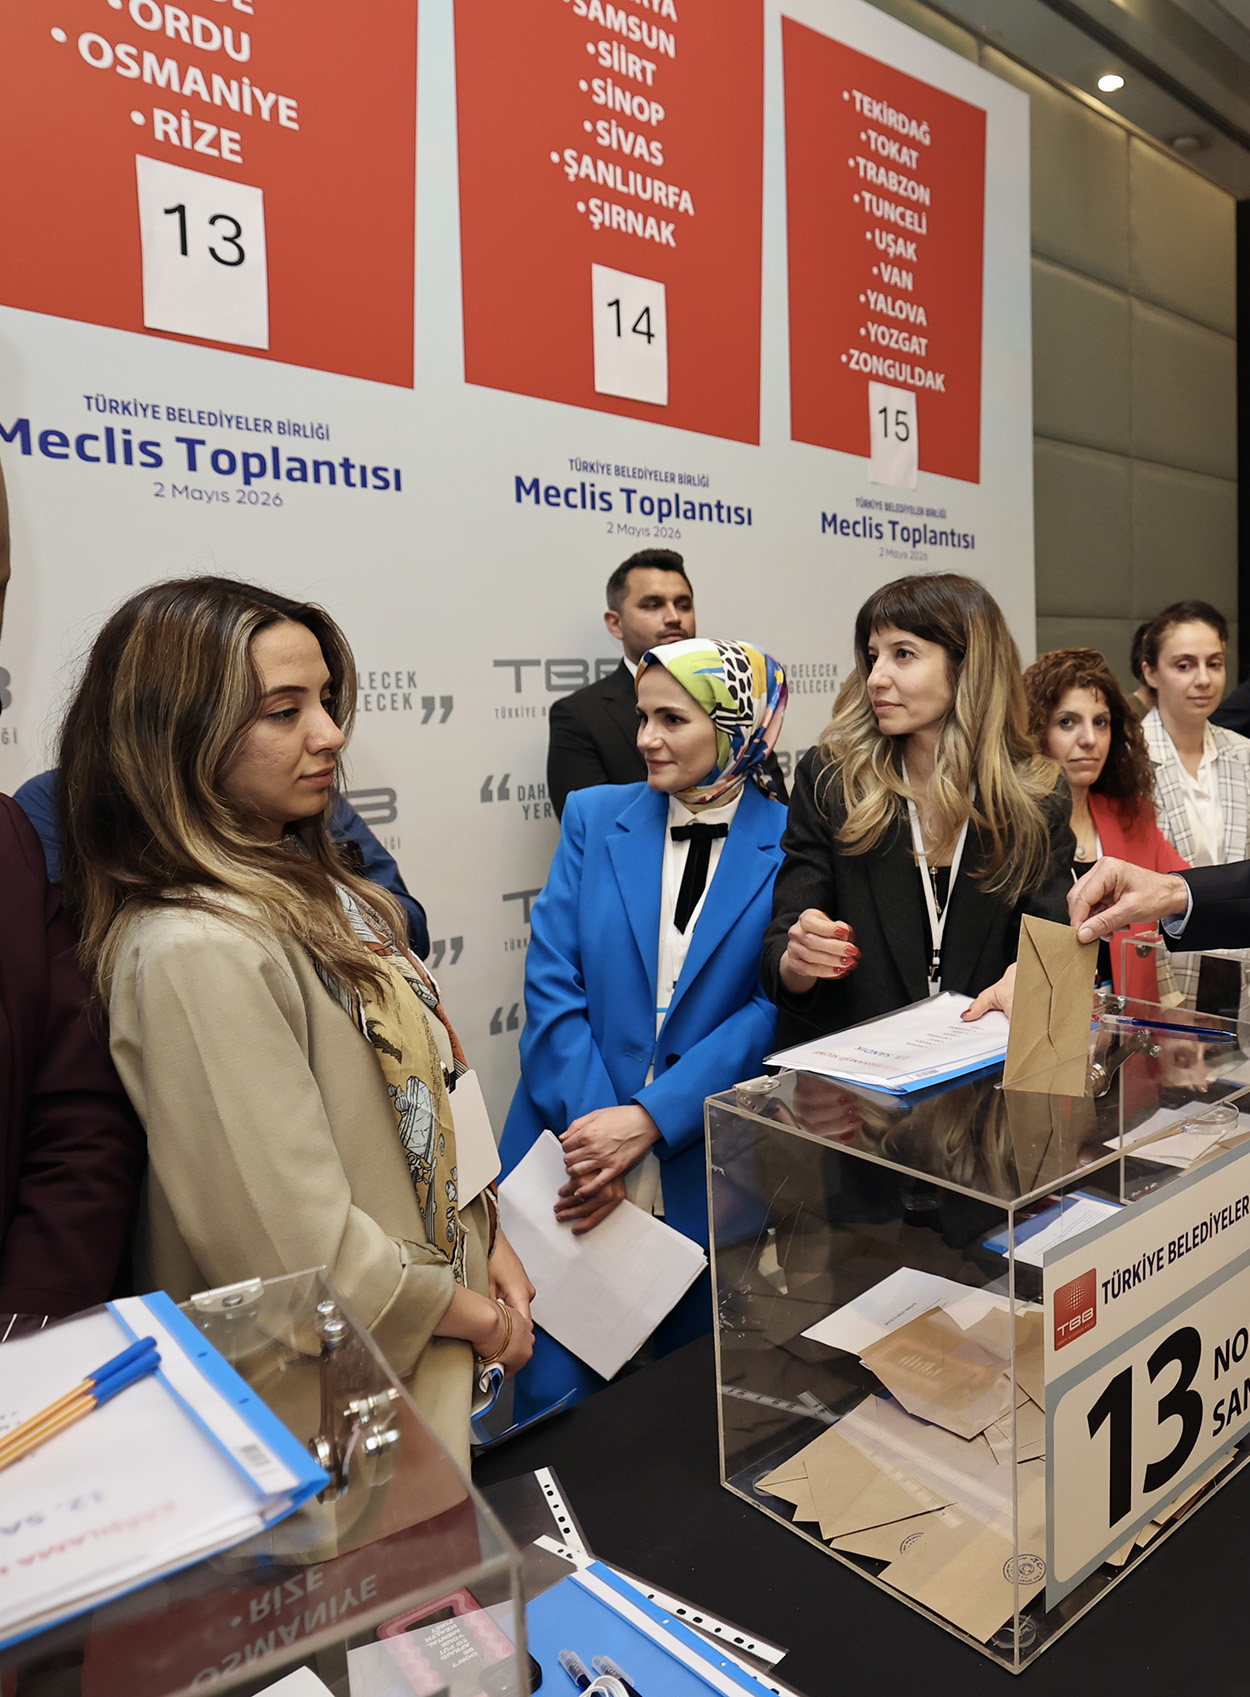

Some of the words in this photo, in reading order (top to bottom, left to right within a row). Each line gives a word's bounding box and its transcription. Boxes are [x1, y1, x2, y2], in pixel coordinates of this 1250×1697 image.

[129, 0, 250, 62] ORDU
[573, 0, 676, 58] SAMSUN
[77, 32, 300, 131] OSMANİYE
[597, 40, 657, 86] SİİRT
[591, 77, 665, 127] SİNOP
[852, 89, 931, 146] TEKİRDAĞ
[153, 107, 243, 164] RİZE
[596, 119, 664, 166] SİVAS
[867, 128, 919, 170] TOKAT
[563, 148, 695, 216] ŞANLIURFA
[856, 155, 931, 207] TRABZON
[588, 197, 677, 248] ŞIRNAK
[861, 190, 927, 236] TUNCELİ
[163, 204, 245, 266] 13
[874, 228, 918, 262] UŞAK
[880, 261, 913, 291] VAN
[607, 298, 655, 344] 14
[866, 288, 927, 327] YALOVA
[867, 321, 928, 357] YOZGAT
[849, 348, 946, 392] ZONGULDAK
[83, 394, 161, 421] TÜRKİYE
[165, 406, 273, 434] BELEDİYELER
[277, 418, 330, 441] BİRLİĞİ
[878, 406, 909, 441] 15
[0, 417, 163, 469] Meclis
[175, 436, 402, 492] Toplantısı
[568, 457, 611, 476] TÜRKİYE
[614, 465, 676, 484] BELEDİYELER
[678, 471, 710, 488] BİRLİĞİ
[153, 481, 166, 498] 2
[172, 483, 229, 505] Mayıs
[236, 489, 283, 508] 2026
[514, 475, 613, 512] Meclis
[620, 488, 753, 526] Toplantısı
[606, 521, 614, 534] 2
[617, 523, 650, 537] Mayıs
[653, 526, 681, 539] 2026
[821, 511, 884, 540] Meclis
[888, 520, 975, 549] Toplantısı
[358, 671, 417, 690] LECEK
[363, 692, 413, 712] ECEK
[495, 705, 536, 719] TÜRKİYE
[518, 783, 550, 802] DAH
[504, 937, 528, 952] TÜRK
[1101, 1246, 1165, 1305] TÜRKİYE
[1167, 1195, 1249, 1265] BELEDİYELER
[1057, 1307, 1094, 1336] TBB
[1087, 1326, 1203, 1529] 13
[424, 1624, 458, 1643] HEALTH
[426, 1629, 461, 1648] MENTAL
[439, 1644, 456, 1656] PUT
[440, 1643, 470, 1661] AFRAID
[441, 1634, 465, 1648] YOUR
[456, 1638, 468, 1647] TO
[452, 1651, 478, 1669] DON'T
